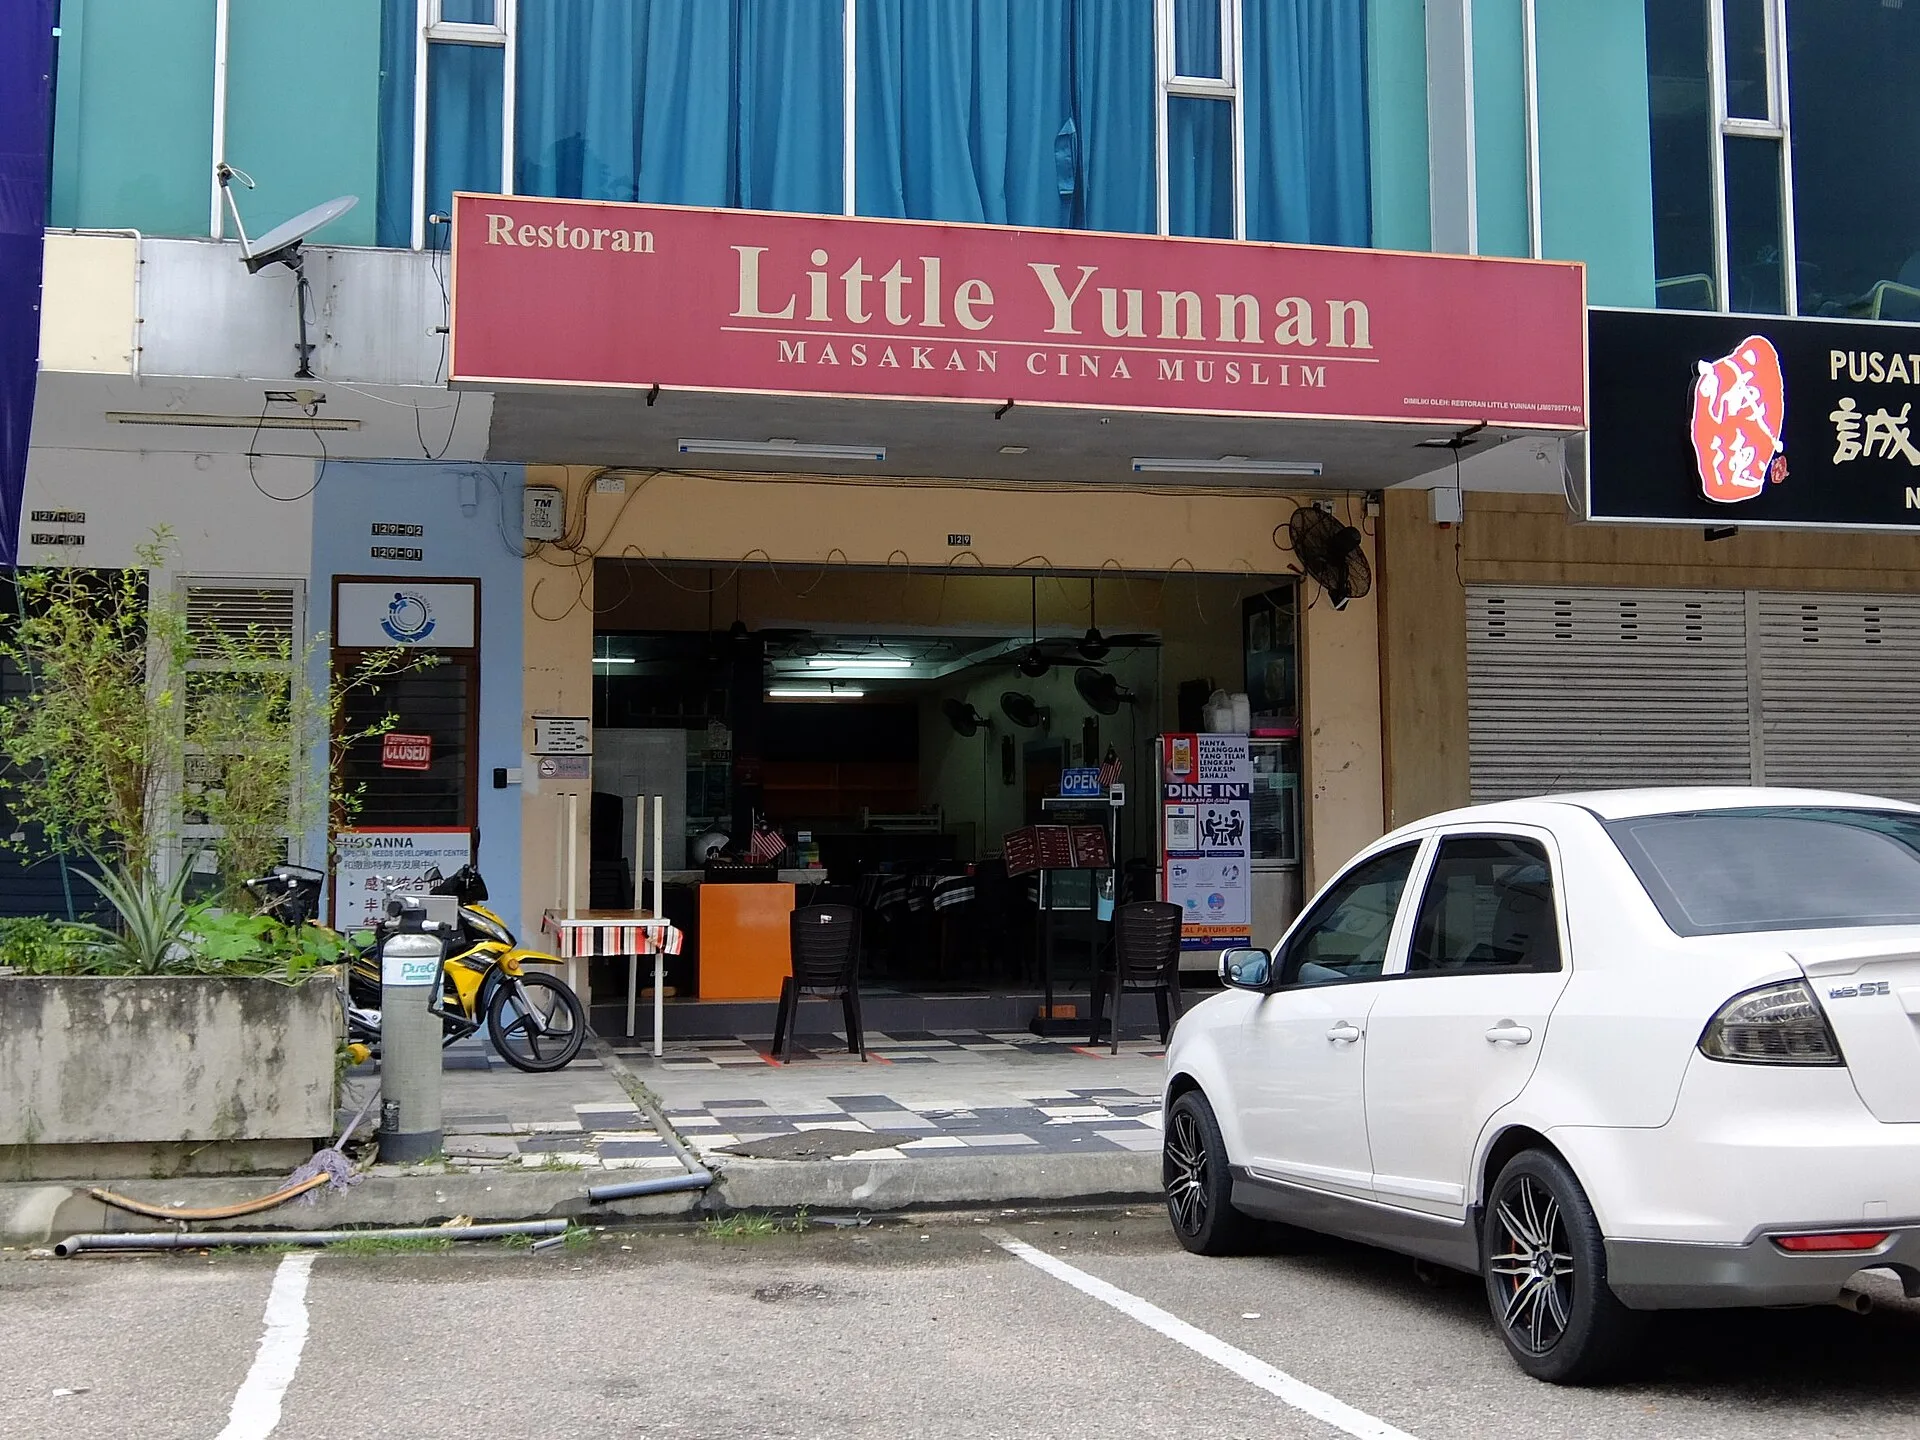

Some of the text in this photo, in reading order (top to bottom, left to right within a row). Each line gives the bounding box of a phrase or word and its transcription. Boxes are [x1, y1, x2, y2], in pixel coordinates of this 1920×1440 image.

[485, 214, 656, 254] Restoran
[729, 245, 1373, 349] Little Yunnan
[777, 340, 1327, 388] MASAKAN CINA MUSLIM
[1830, 350, 1920, 385] PUSAT
[1451, 399, 1486, 408] RESTORAN
[1487, 401, 1509, 409] LITTLE
[1509, 402, 1536, 411] YUNNAN
[534, 499, 552, 507] TM
[32, 511, 85, 522] 127-02
[373, 524, 422, 536] 129-02
[32, 534, 85, 545] 127-01
[949, 535, 970, 544] 129
[372, 547, 422, 559] 129-01
[386, 743, 427, 760] CLOSED
[1064, 774, 1098, 789] OPEN
[344, 838, 413, 848] HOSANNA
